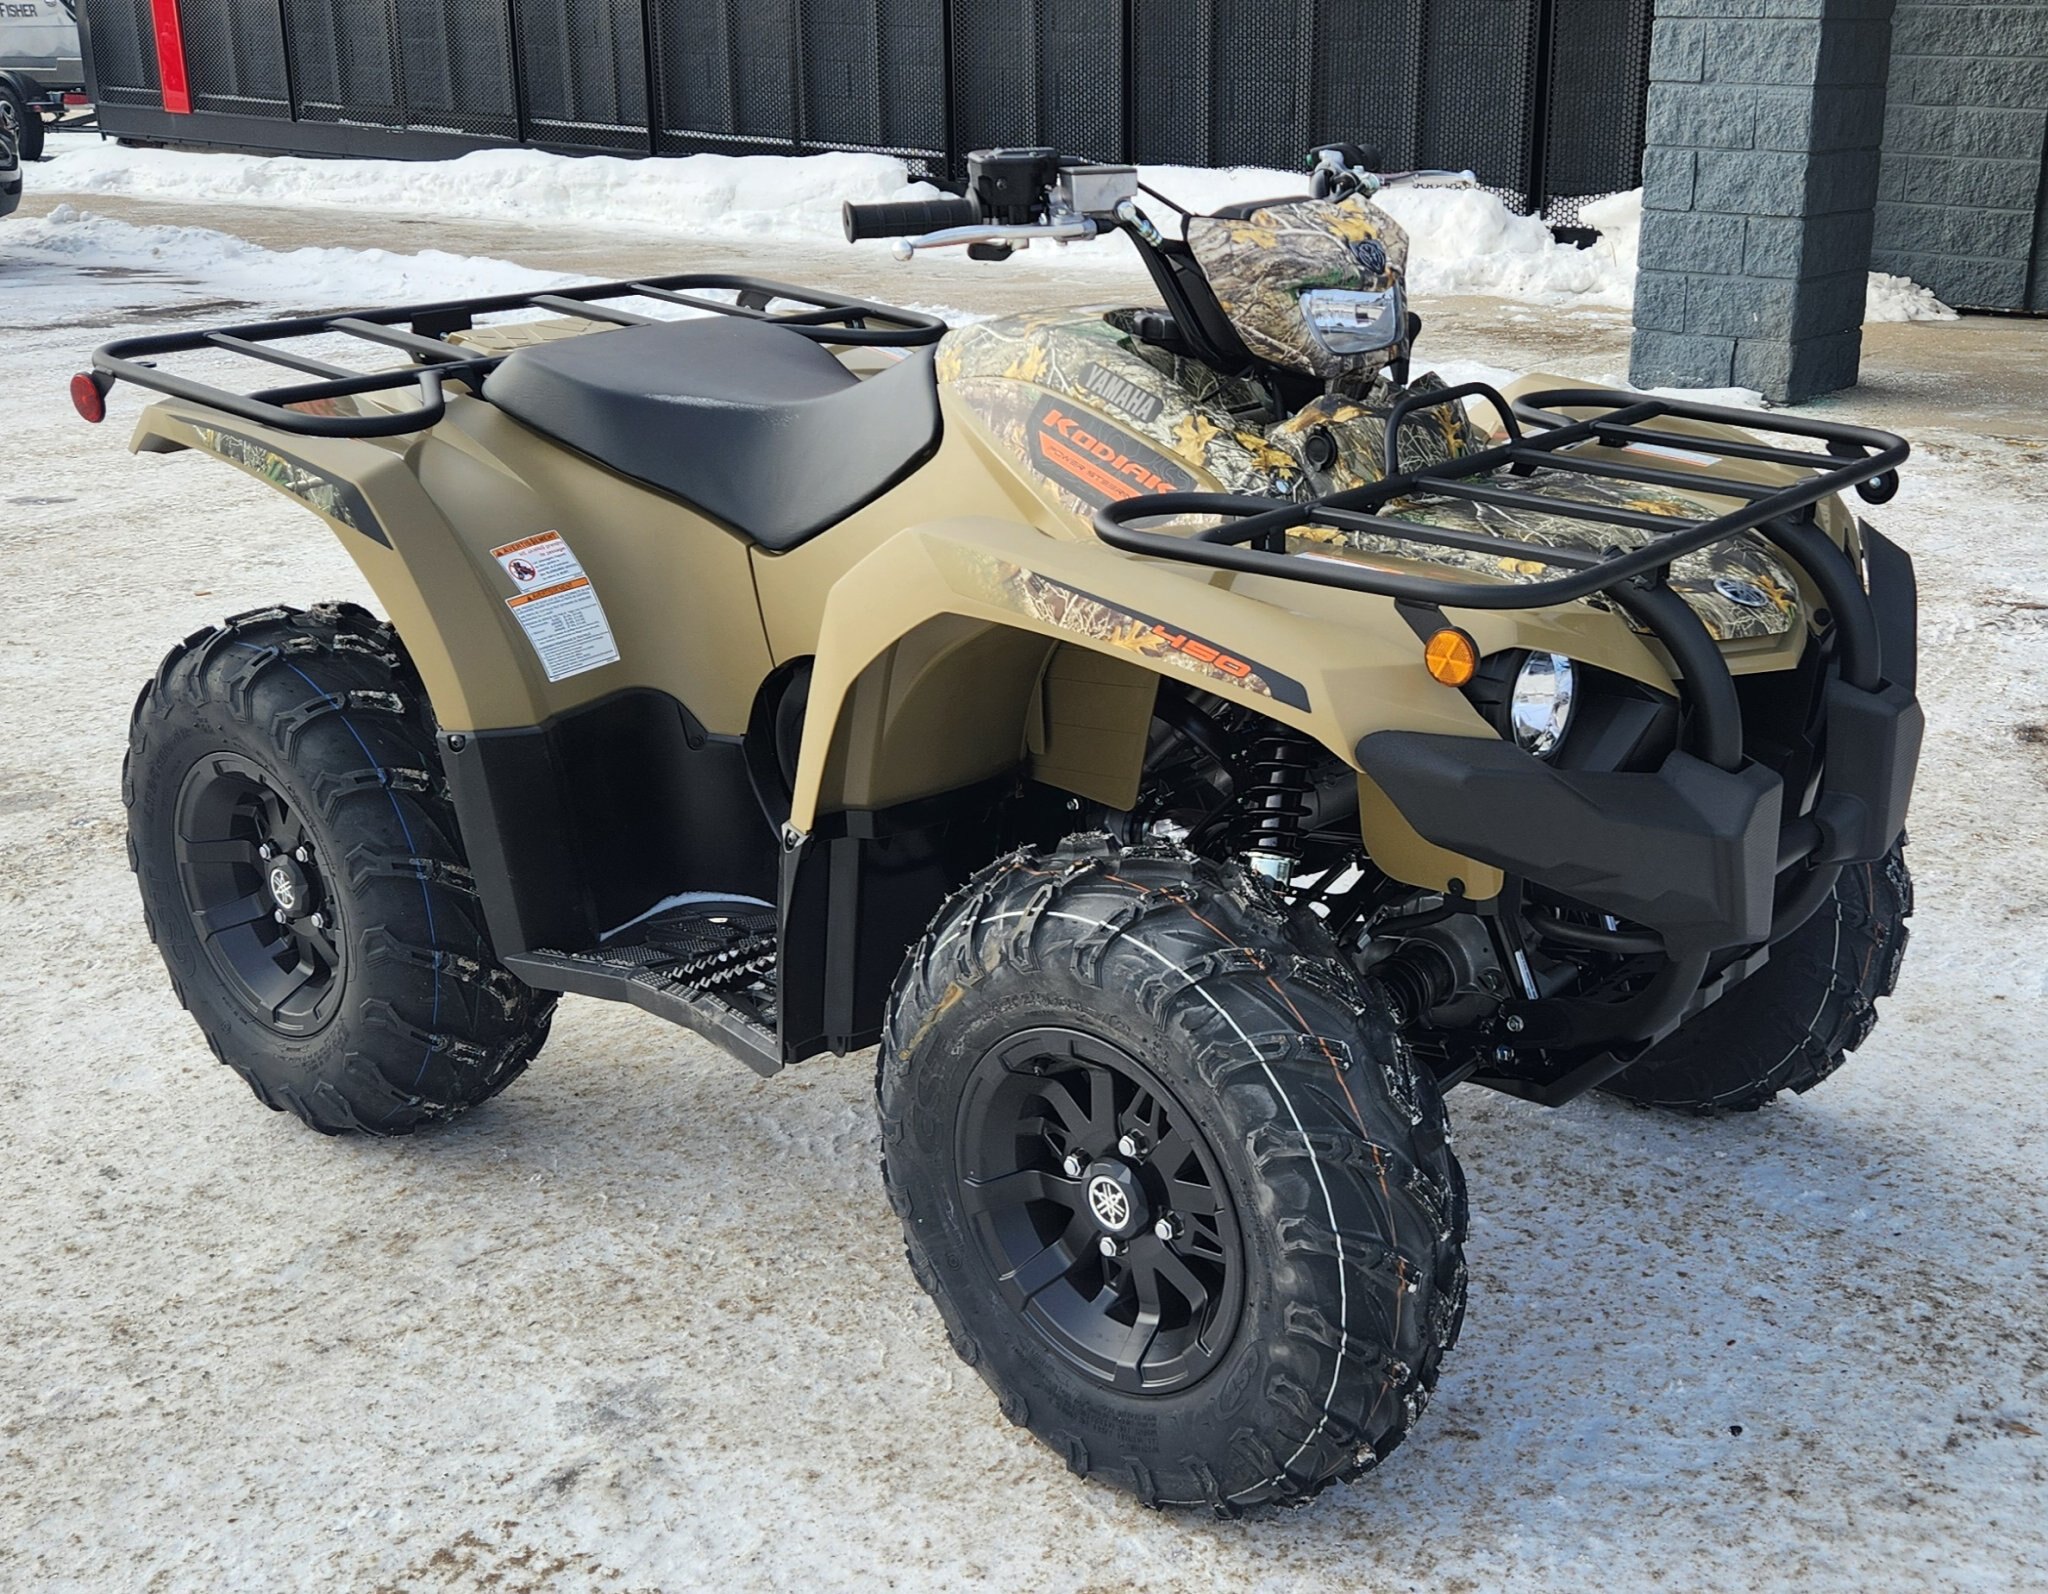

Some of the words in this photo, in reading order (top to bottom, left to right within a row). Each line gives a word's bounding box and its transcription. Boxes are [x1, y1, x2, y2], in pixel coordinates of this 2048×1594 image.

[0, 3, 38, 18] FISHER
[1085, 363, 1157, 421] YAMAHA
[1042, 408, 1178, 494] KODIAK
[1047, 445, 1086, 471] POWER
[1152, 624, 1253, 679] 450
